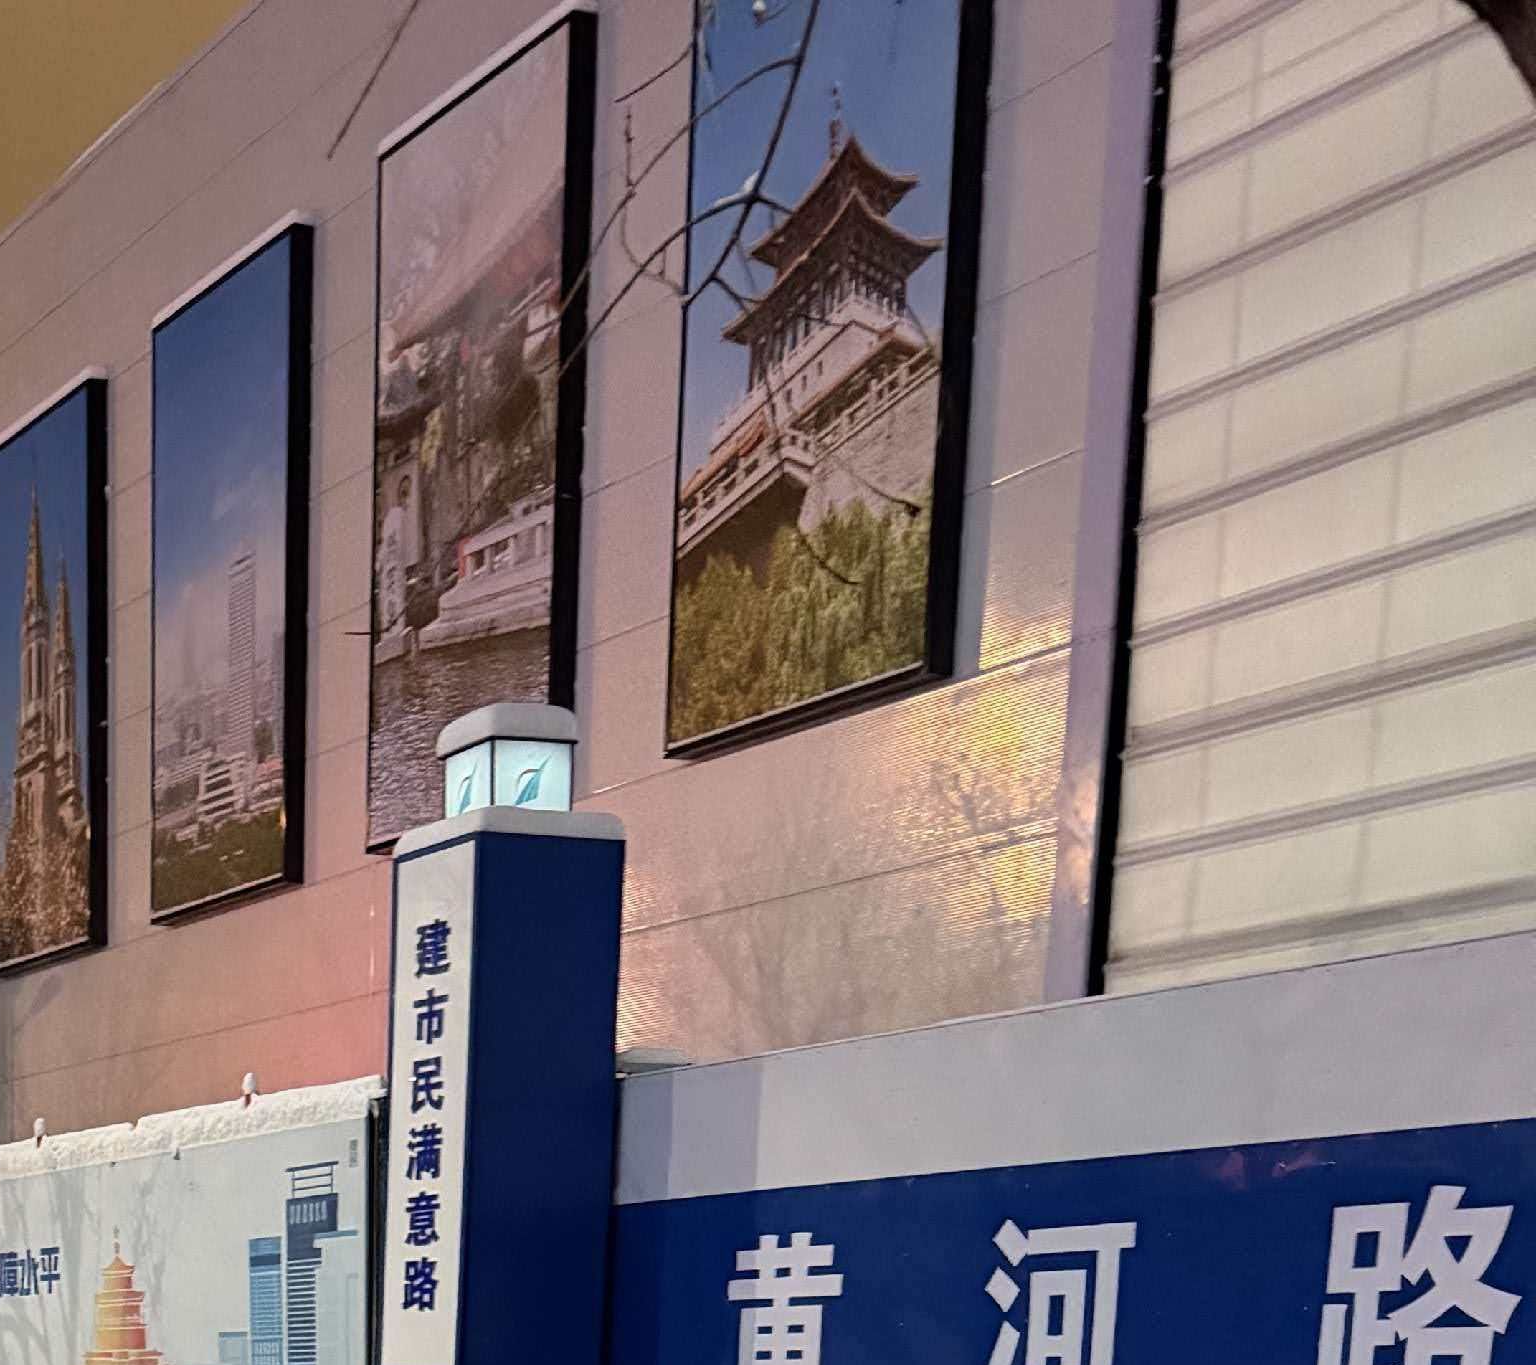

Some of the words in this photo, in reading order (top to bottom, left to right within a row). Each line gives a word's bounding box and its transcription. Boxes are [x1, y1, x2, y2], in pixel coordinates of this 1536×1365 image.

[402, 918, 450, 1312] 建市民满意路
